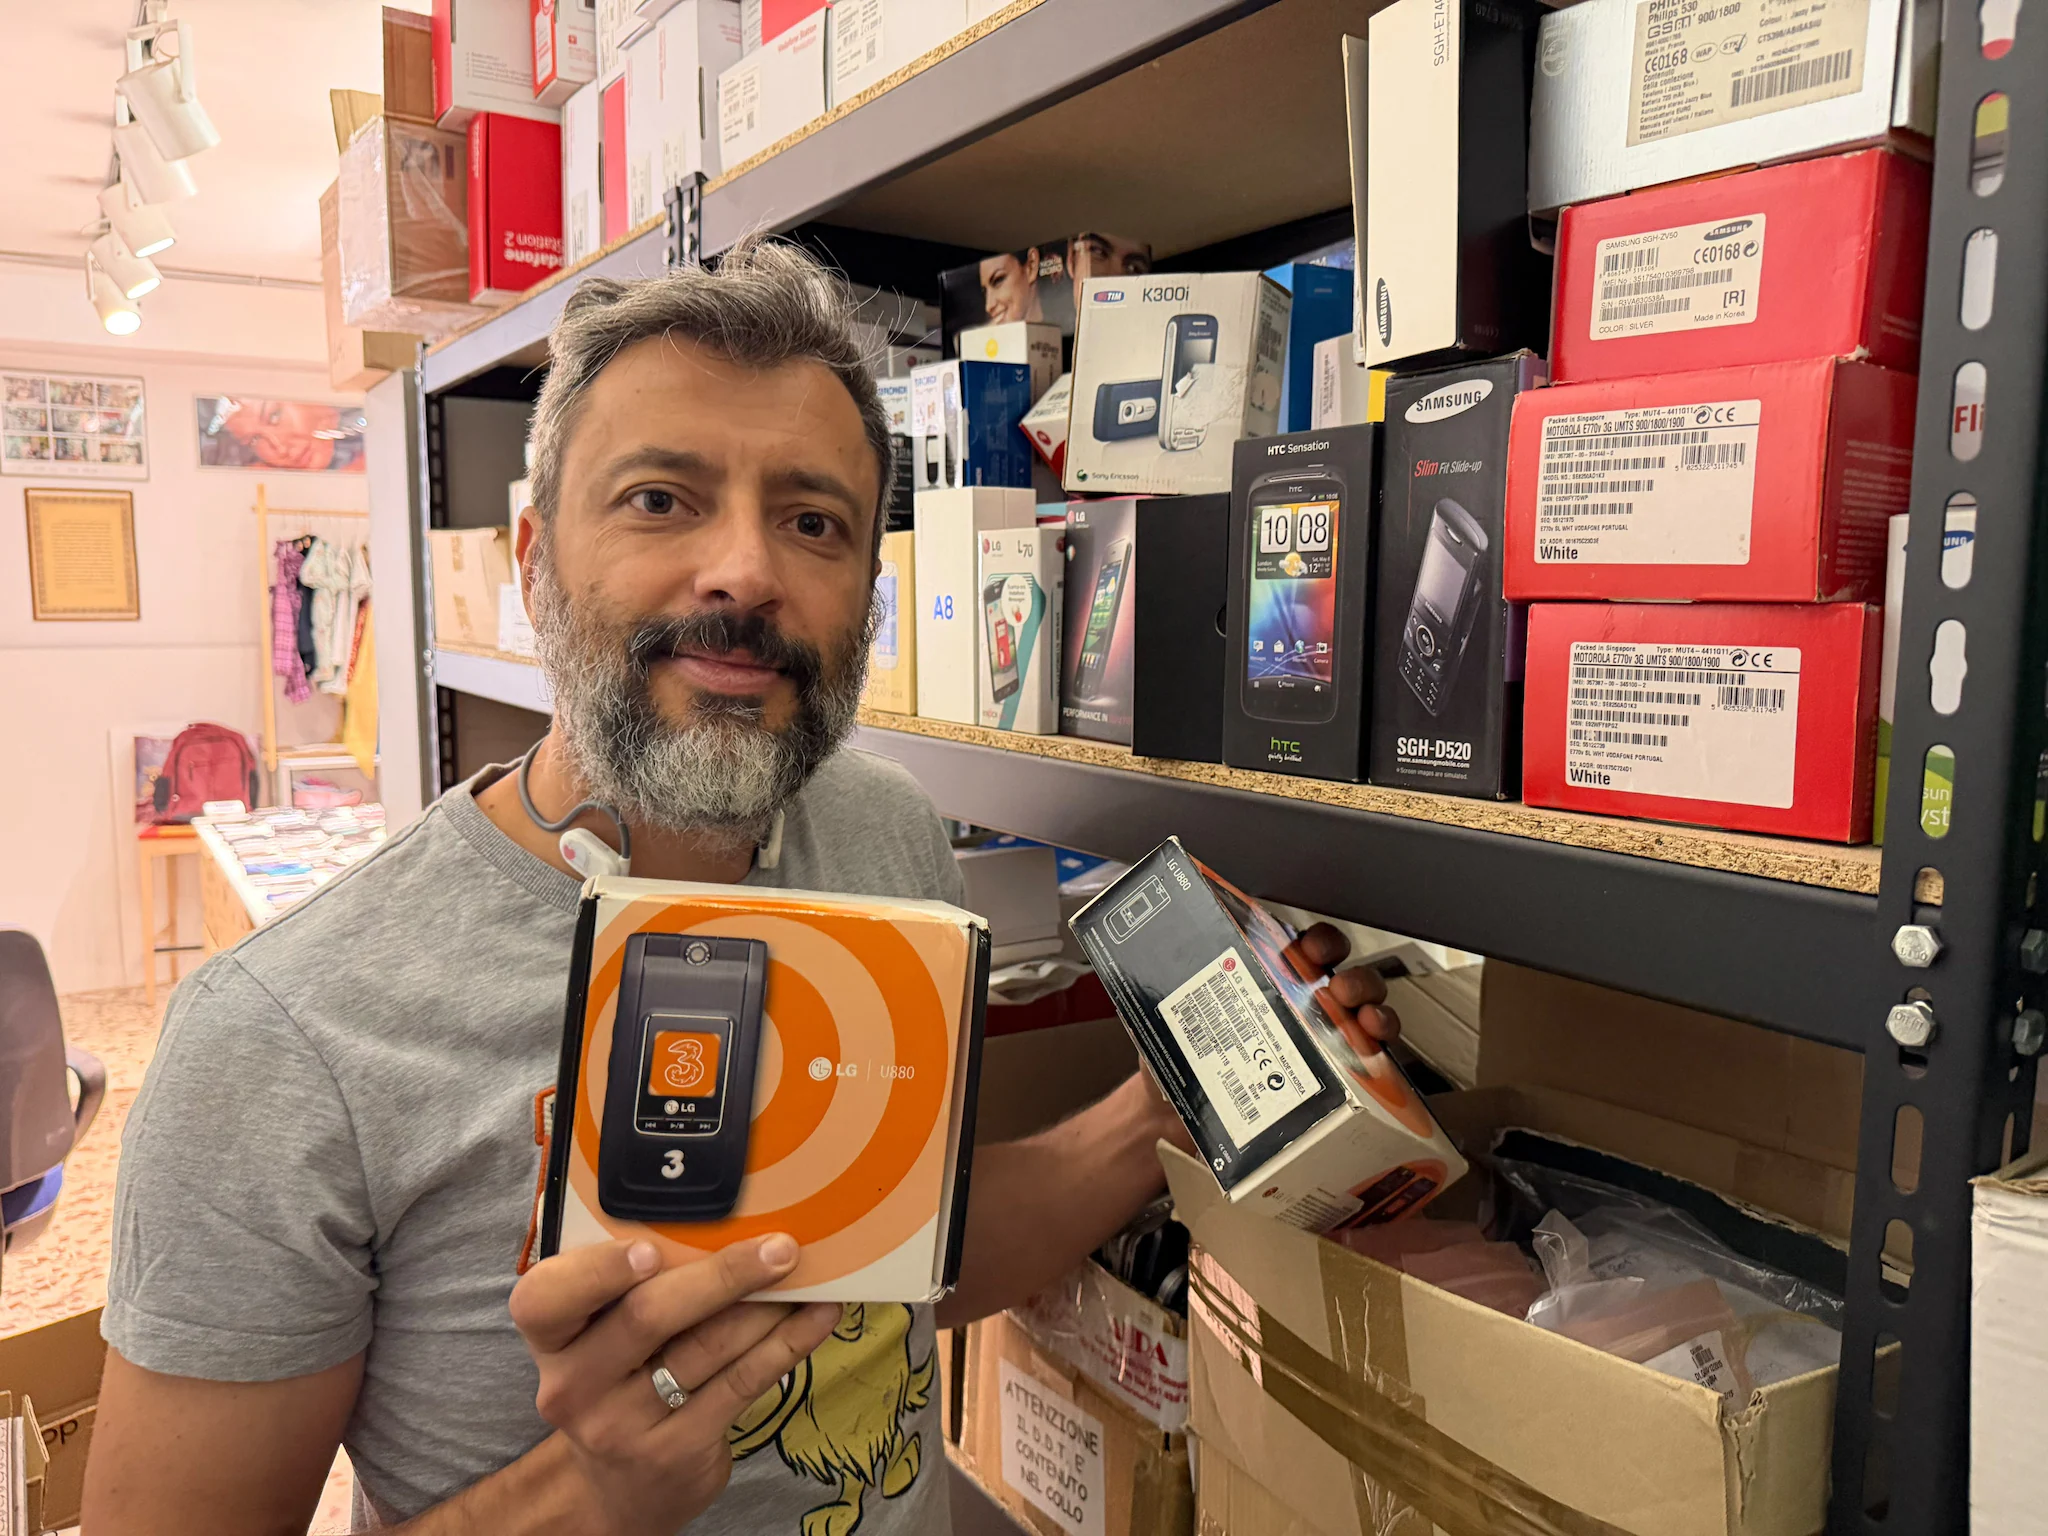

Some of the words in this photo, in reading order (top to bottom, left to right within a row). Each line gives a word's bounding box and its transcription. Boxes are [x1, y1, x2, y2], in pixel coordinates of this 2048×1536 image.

[1648, 9, 1678, 24] Philips
[1682, 1, 1698, 14] 530
[1648, 16, 1691, 39] GSM
[1698, 2, 1741, 24] 900/1800
[1696, 47, 1712, 58] WAP
[1606, 238, 1641, 250] SAMSUNG
[1642, 231, 1679, 244] SGH-ZV50
[1107, 292, 1122, 301] TIM
[1142, 286, 1190, 303] K300i
[1380, 285, 1389, 341] SAMSUNG
[1694, 314, 1714, 322] Made
[1723, 310, 1746, 318] Korea
[1629, 320, 1654, 330] SILVER
[1416, 390, 1482, 412] SAMSUNG
[1548, 416, 1568, 424] Packed
[1577, 414, 1605, 423] Singapore
[1624, 411, 1641, 420] Type:
[1546, 424, 1581, 436] MOTOROLA
[1583, 422, 1602, 434] E770v
[1603, 421, 1612, 432] 3G
[1614, 420, 1634, 432] UMTS
[1635, 416, 1685, 431] 900/1800/1900
[1268, 445, 1286, 456] HTC
[1288, 440, 1330, 454] Sensation
[1092, 472, 1109, 481] Sony
[1110, 472, 1139, 480] Ericsson
[1414, 460, 1438, 478] Slim
[1438, 464, 1450, 474] Fit
[1450, 460, 1482, 474] Slide-up
[1076, 512, 1086, 522] LG
[1264, 515, 1288, 546] 10
[1300, 512, 1327, 544] 08
[992, 541, 1002, 551] LG
[1018, 540, 1034, 558] L70
[1540, 545, 1578, 560] White
[933, 595, 954, 620] A8
[1606, 645, 1636, 654] Singapore
[1656, 646, 1674, 654] Type:
[1574, 652, 1610, 664] MOTOROLA
[1612, 654, 1632, 664] E770v
[1634, 654, 1644, 665] 3G
[1646, 655, 1666, 666] UMTS
[1668, 655, 1720, 668] 900/1800/1900
[1062, 707, 1101, 722] PERFORMANCE
[1396, 736, 1472, 761] SGH-D520
[1592, 750, 1604, 758] WHT
[1606, 752, 1634, 760] VODAFONE
[1634, 754, 1664, 762] PORTUGAL
[1397, 756, 1470, 769] www.samsungmobile.com
[1570, 768, 1611, 786] White
[1166, 857, 1177, 871] LG
[1173, 868, 1192, 892] U880
[1230, 970, 1243, 984] LG
[664, 1038, 704, 1088] 3
[836, 1064, 858, 1078] LG
[880, 1065, 915, 1080] U880
[1278, 1054, 1291, 1071] MADE
[1290, 1074, 1306, 1095] KOREA
[1246, 1083, 1262, 1101] Silver
[680, 1102, 696, 1114] LG
[661, 1149, 686, 1179] 3
[1004, 1380, 1098, 1456] ATTENZIONE
[1016, 1414, 1030, 1436] IL
[1016, 1440, 1088, 1502] CONTENUTO
[1020, 1466, 1042, 1494] NEL
[1045, 1488, 1084, 1524] COLLO
